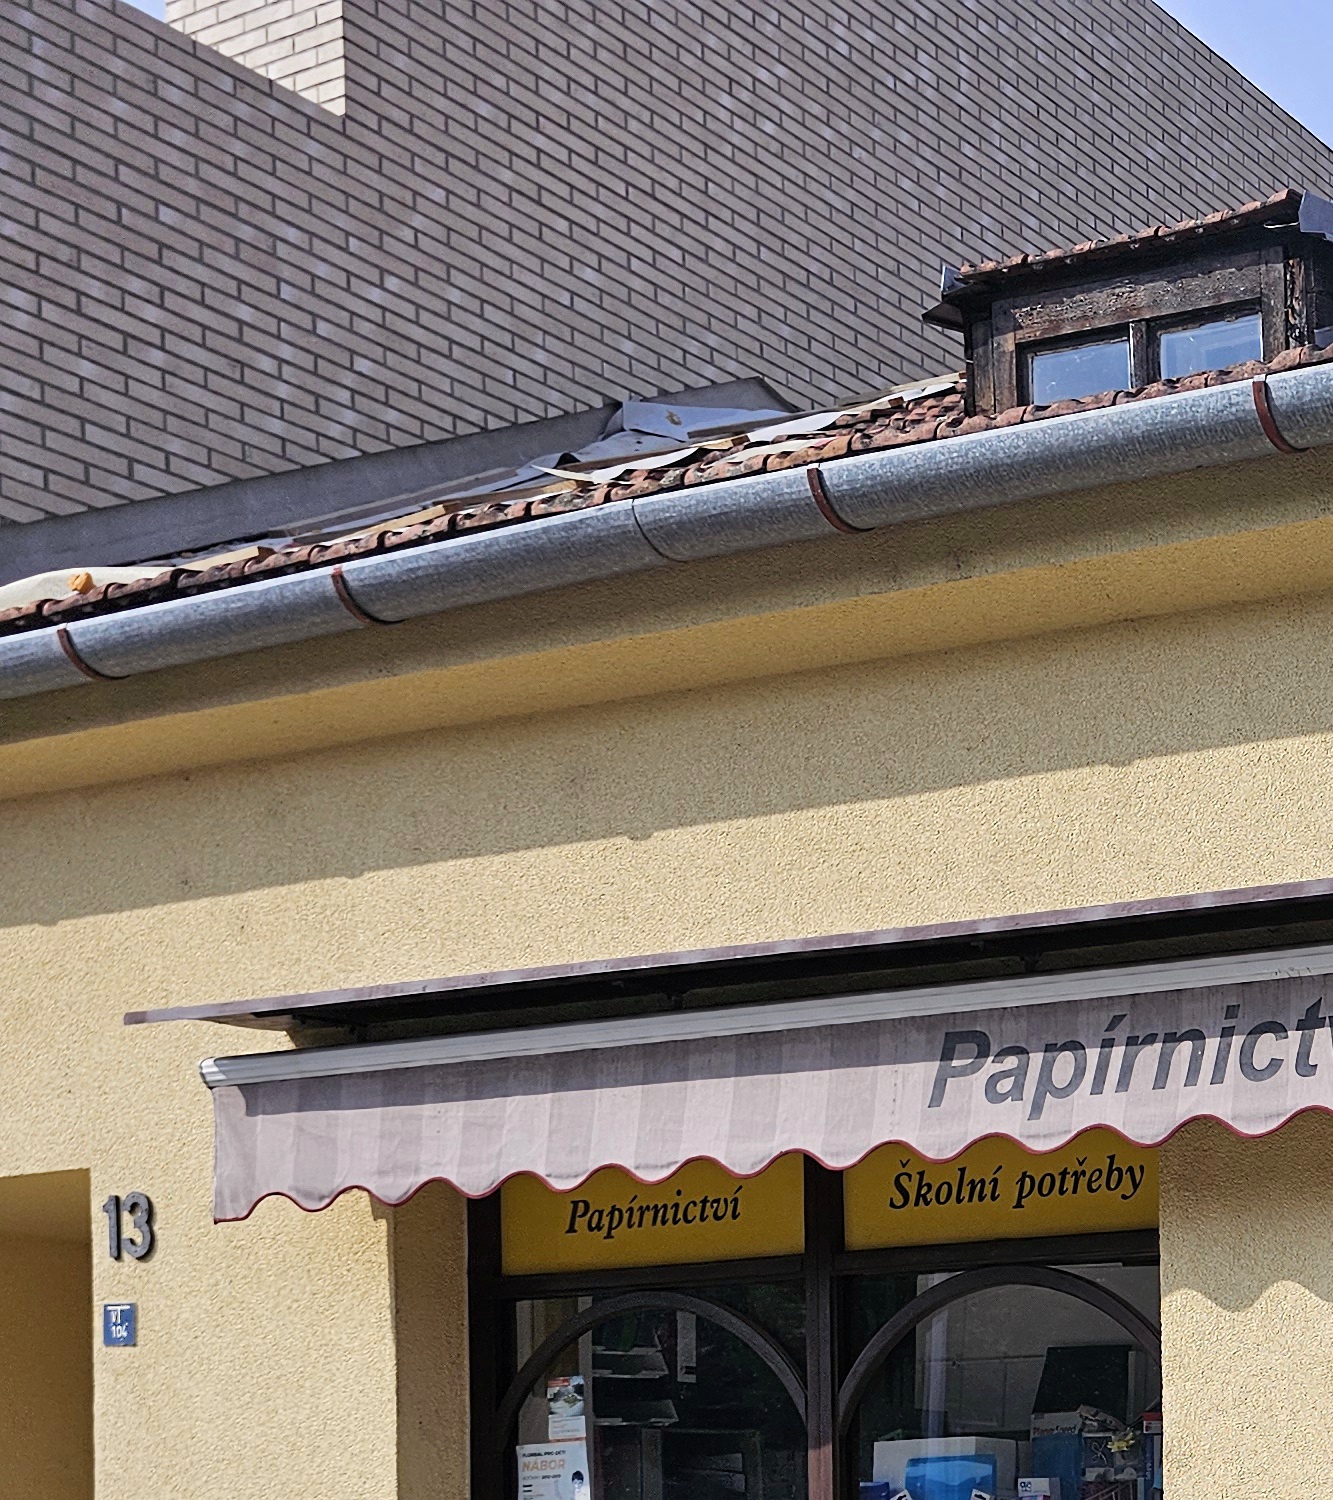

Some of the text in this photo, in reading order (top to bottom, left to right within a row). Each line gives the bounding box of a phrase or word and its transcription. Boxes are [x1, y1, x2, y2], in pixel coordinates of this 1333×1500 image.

[888, 1153, 1146, 1210] Školní potřeby
[103, 1191, 151, 1260] 13
[565, 1185, 743, 1240] Papírnictví
[522, 1458, 566, 1472] NÁBOR
